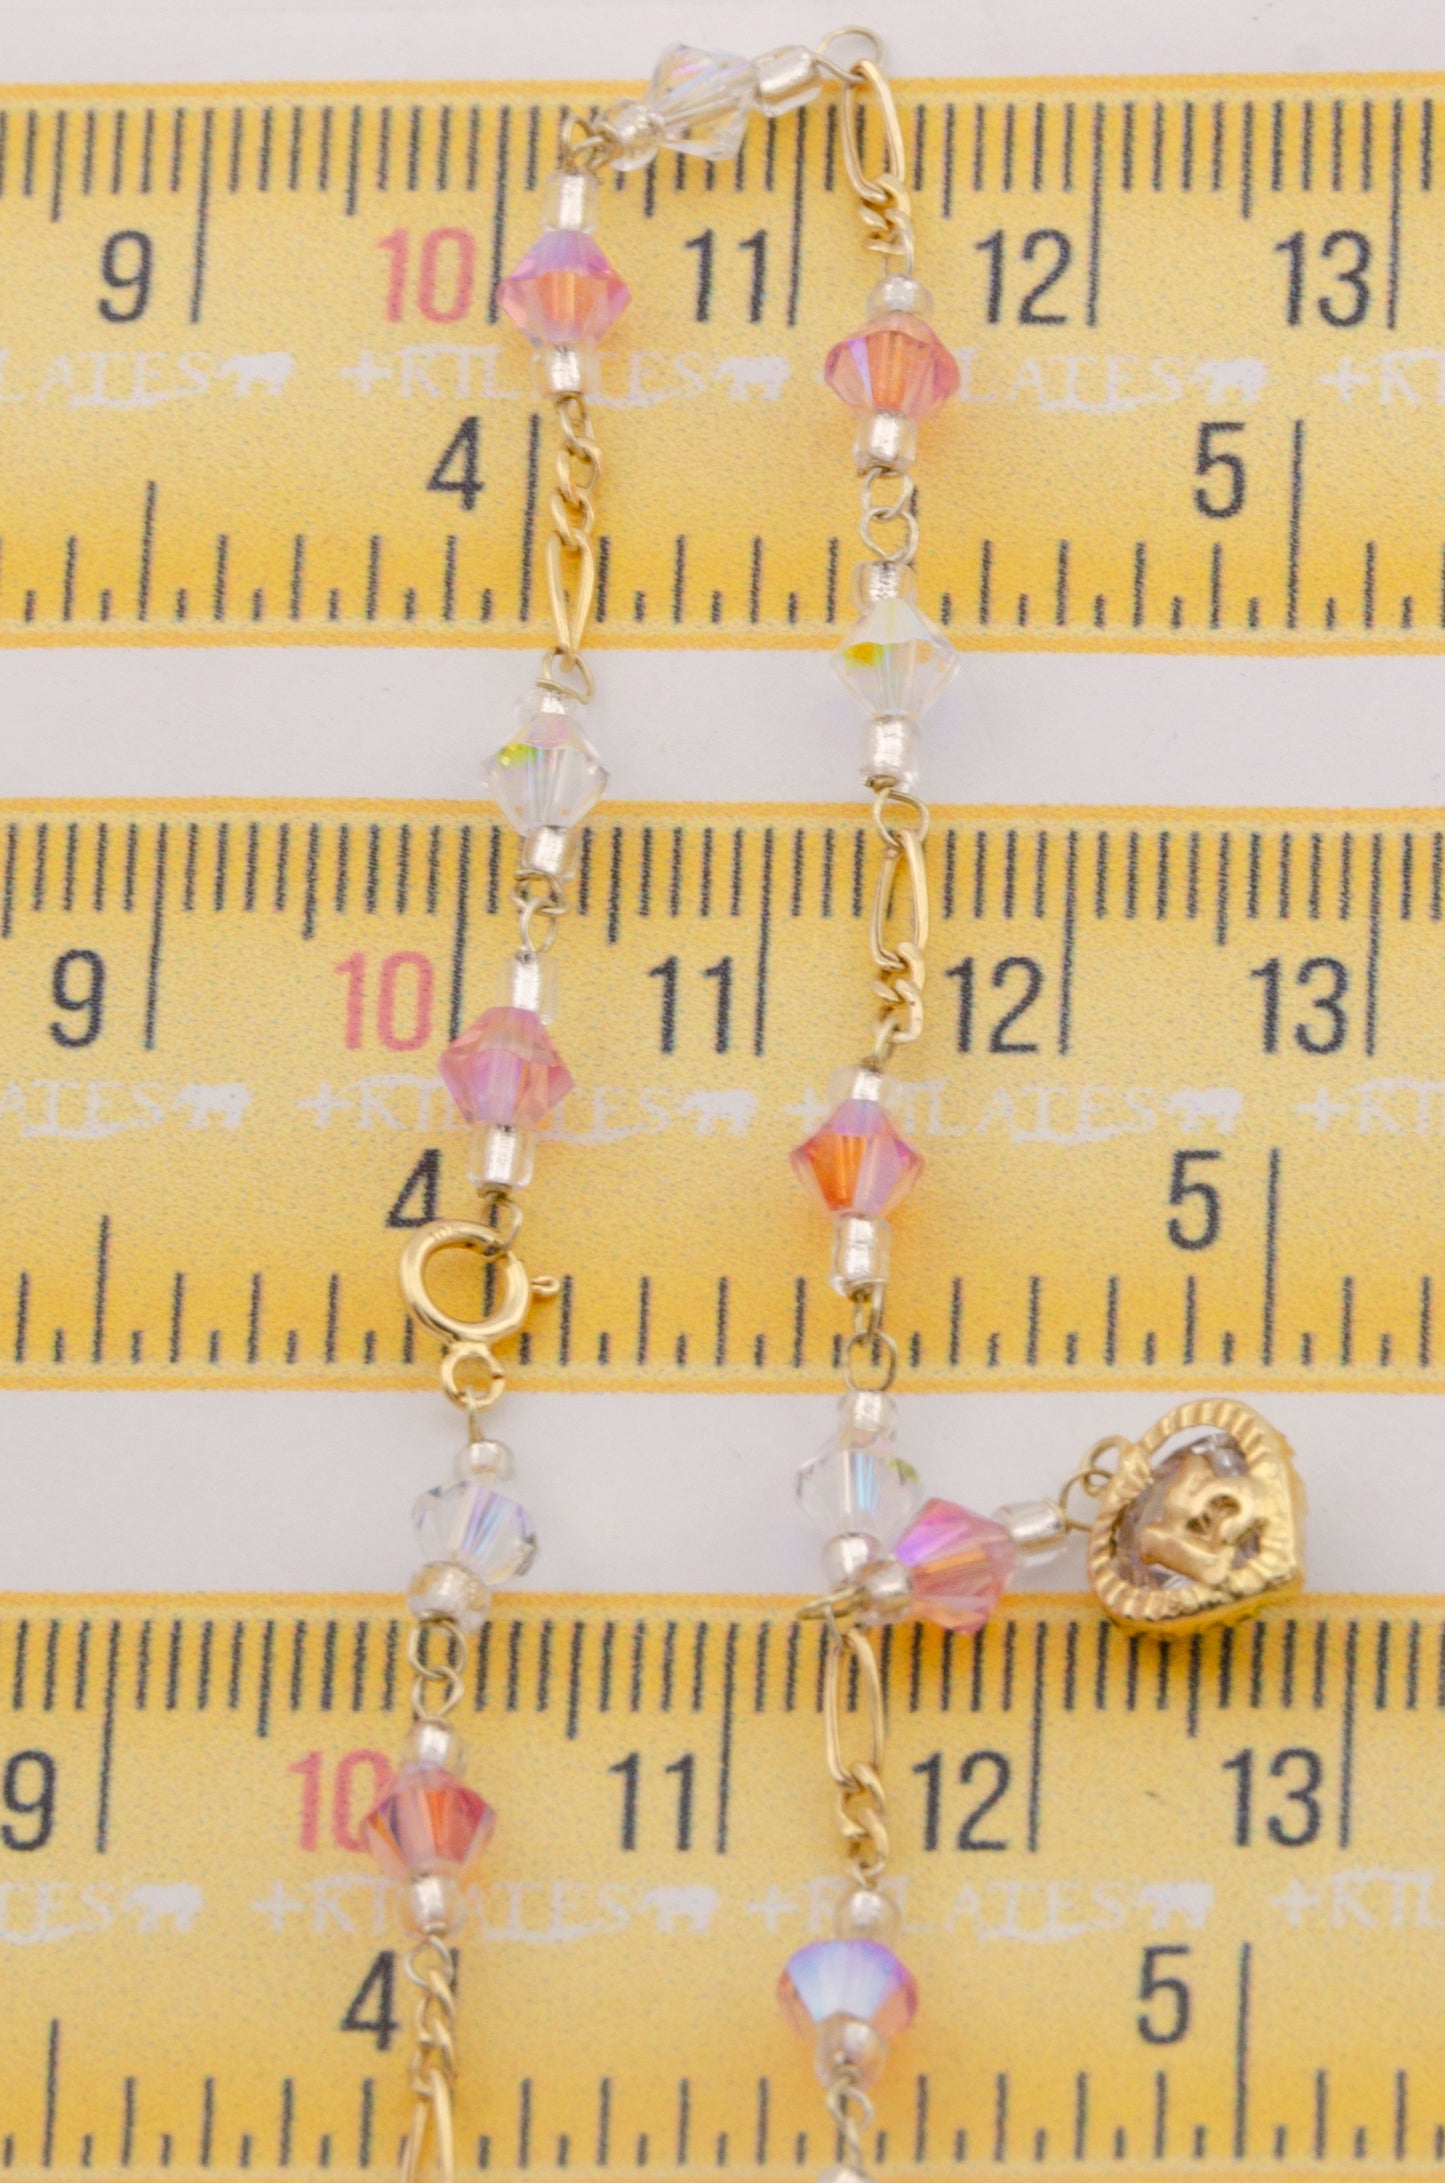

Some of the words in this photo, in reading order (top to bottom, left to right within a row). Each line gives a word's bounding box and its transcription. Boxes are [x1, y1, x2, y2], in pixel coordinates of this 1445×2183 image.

[98, 229, 153, 324] 9
[377, 227, 477, 324] 10
[685, 228, 768, 324] 11
[975, 228, 1073, 326] 12
[1274, 229, 1373, 329] 13
[426, 415, 485, 512] 4
[1193, 420, 1247, 520] 5
[48, 948, 106, 1050] 9
[333, 950, 435, 1053] 10
[647, 955, 734, 1055] 11
[944, 955, 1045, 1055] 12
[1248, 956, 1349, 1056] 13
[382, 1147, 444, 1230] 4
[1166, 1148, 1222, 1253] 5
[0, 1748, 58, 1853] 9
[287, 1748, 398, 1854] 10
[609, 1751, 695, 1852] 11
[911, 1748, 1012, 1853] 12
[1221, 1746, 1324, 1849] 13
[339, 1949, 400, 2053] 4
[1136, 1944, 1191, 2046] 5
